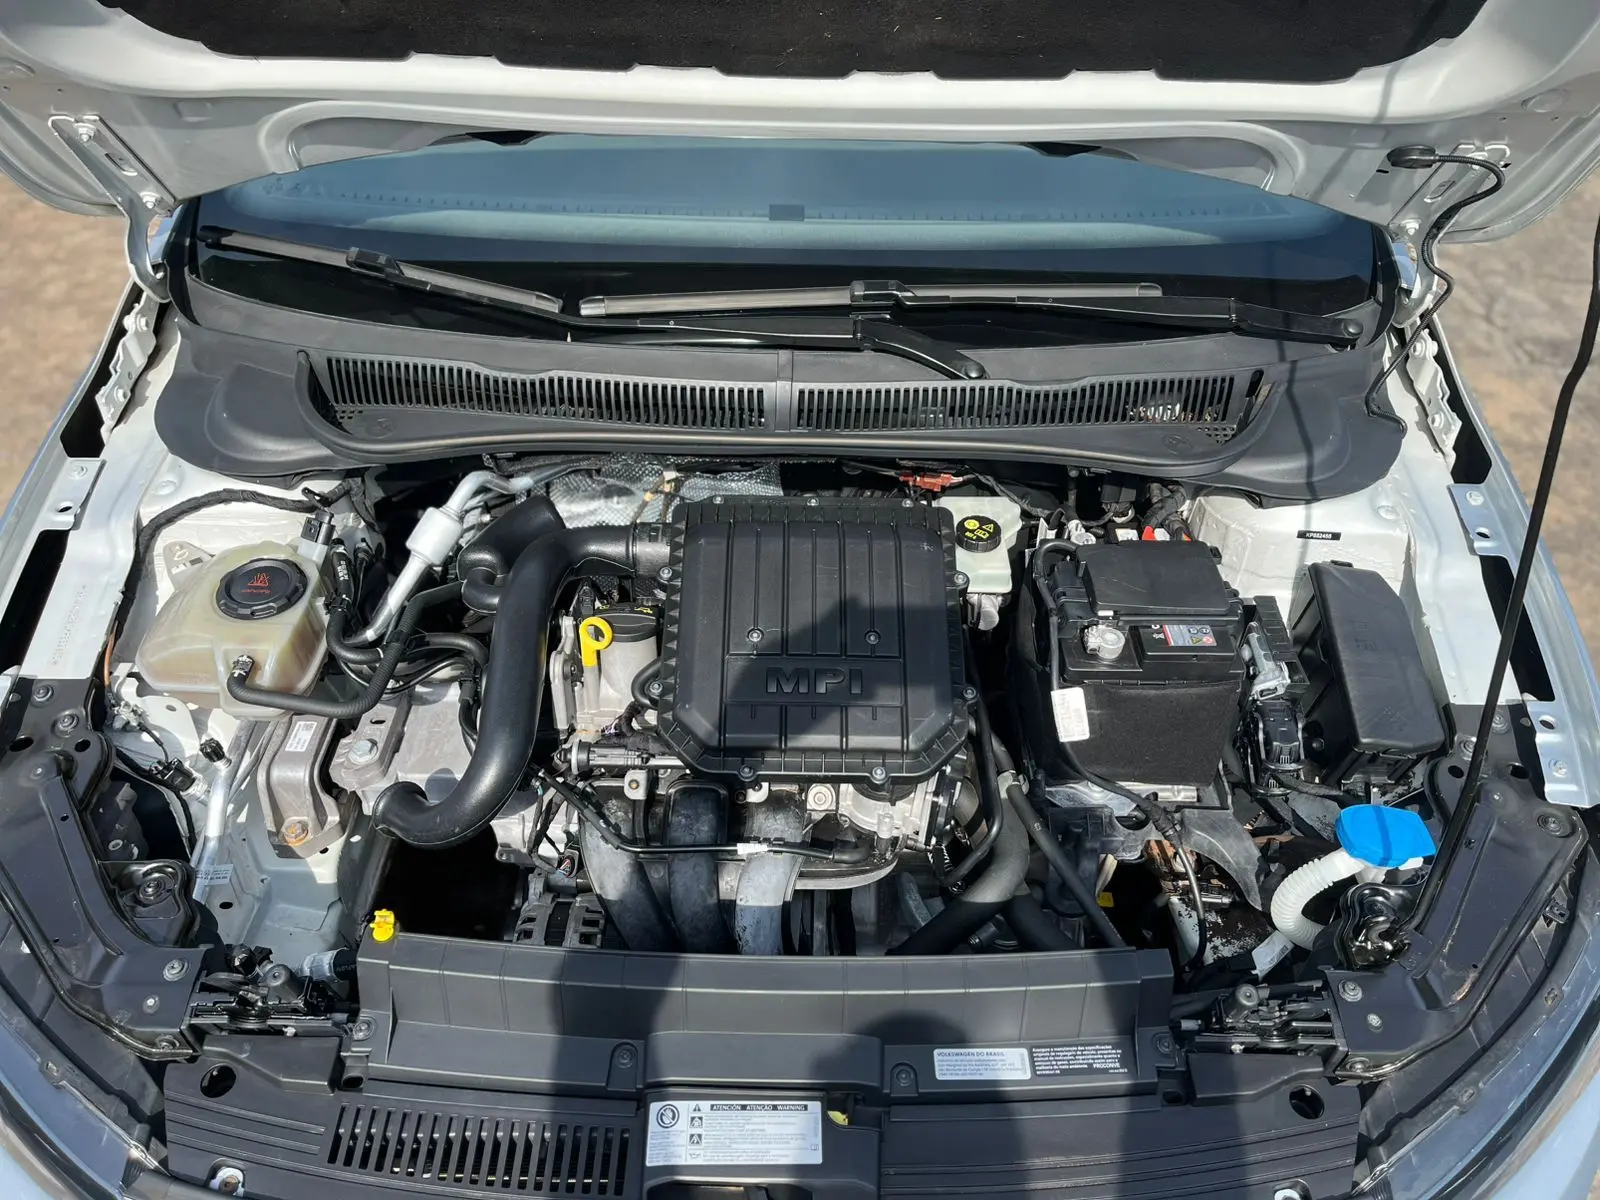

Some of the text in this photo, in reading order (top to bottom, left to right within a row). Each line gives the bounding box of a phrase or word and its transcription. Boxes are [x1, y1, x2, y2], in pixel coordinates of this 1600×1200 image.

[765, 666, 863, 695] MPI
[712, 1103, 806, 1112] ATENCIÓN ATENÇÃO WARNING
